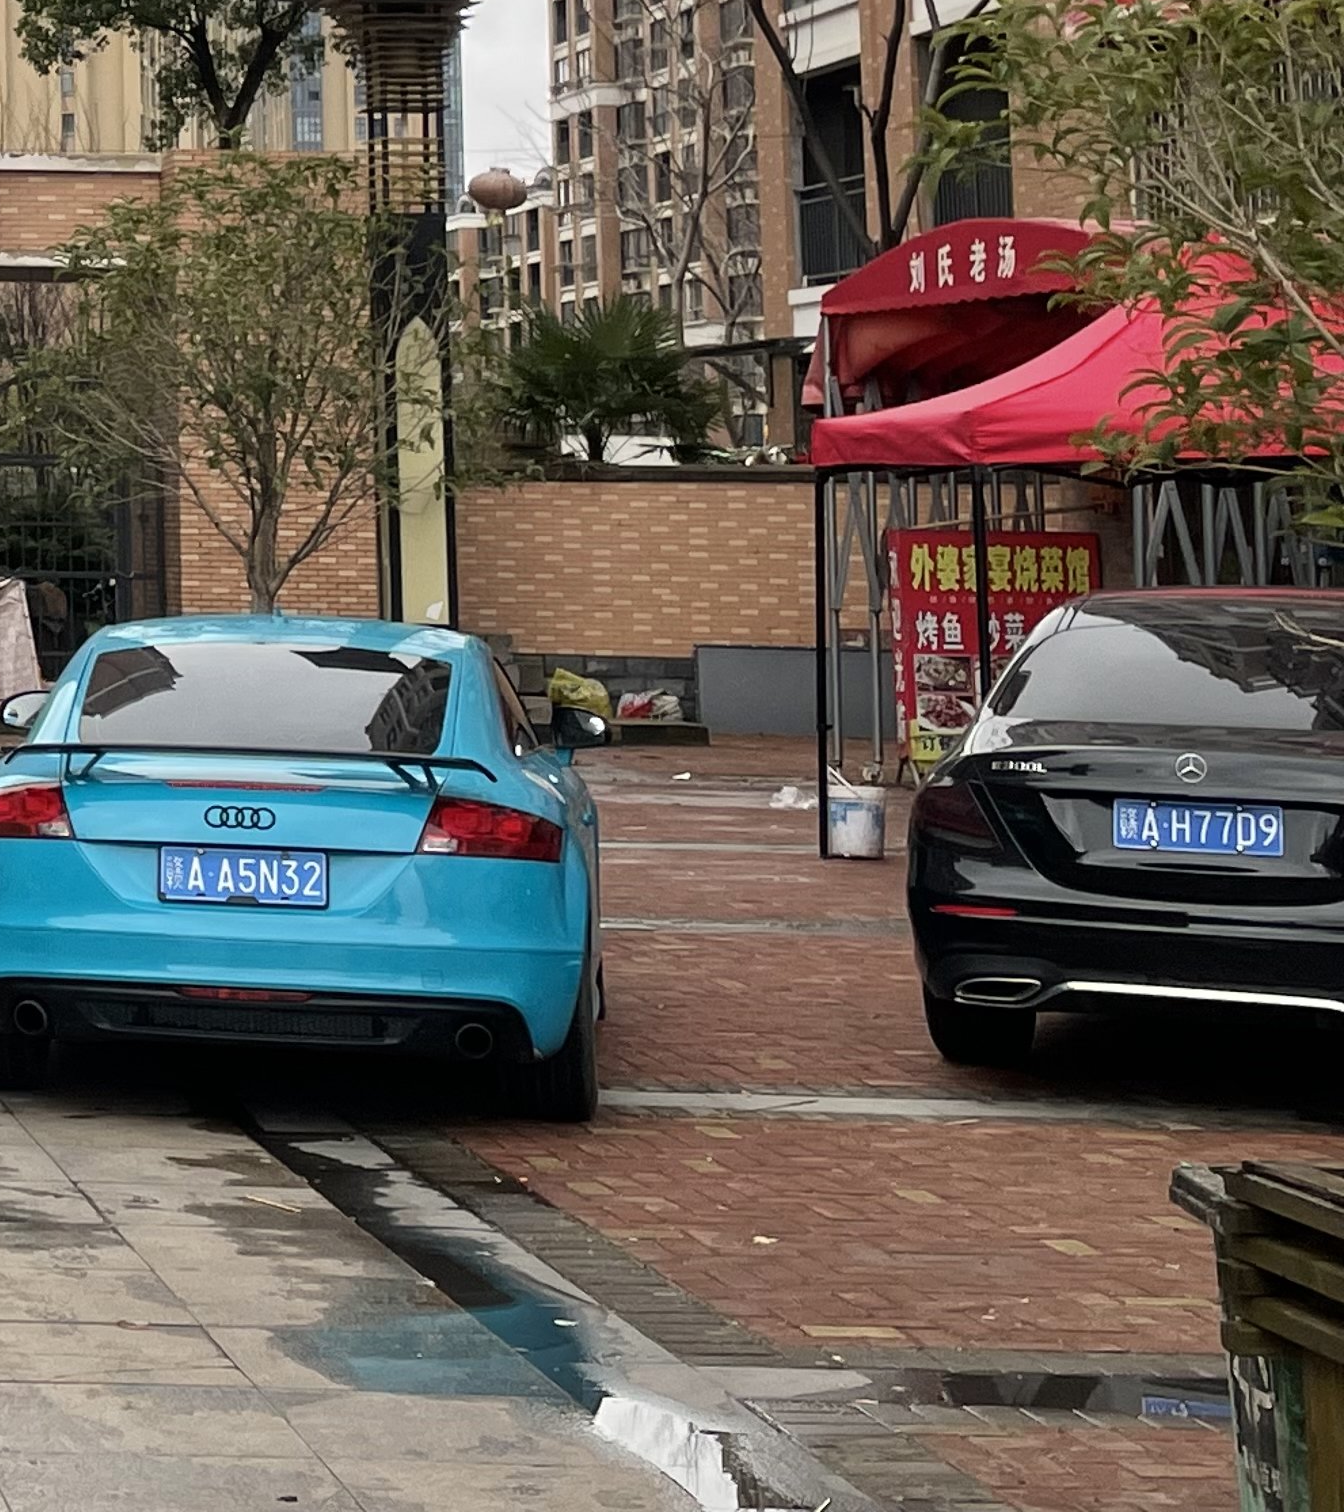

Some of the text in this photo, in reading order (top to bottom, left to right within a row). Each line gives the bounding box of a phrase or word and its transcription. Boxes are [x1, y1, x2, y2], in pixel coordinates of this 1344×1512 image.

[909, 235, 1016, 294] 刘氏老汤
[915, 610, 965, 650] 烤鱼
